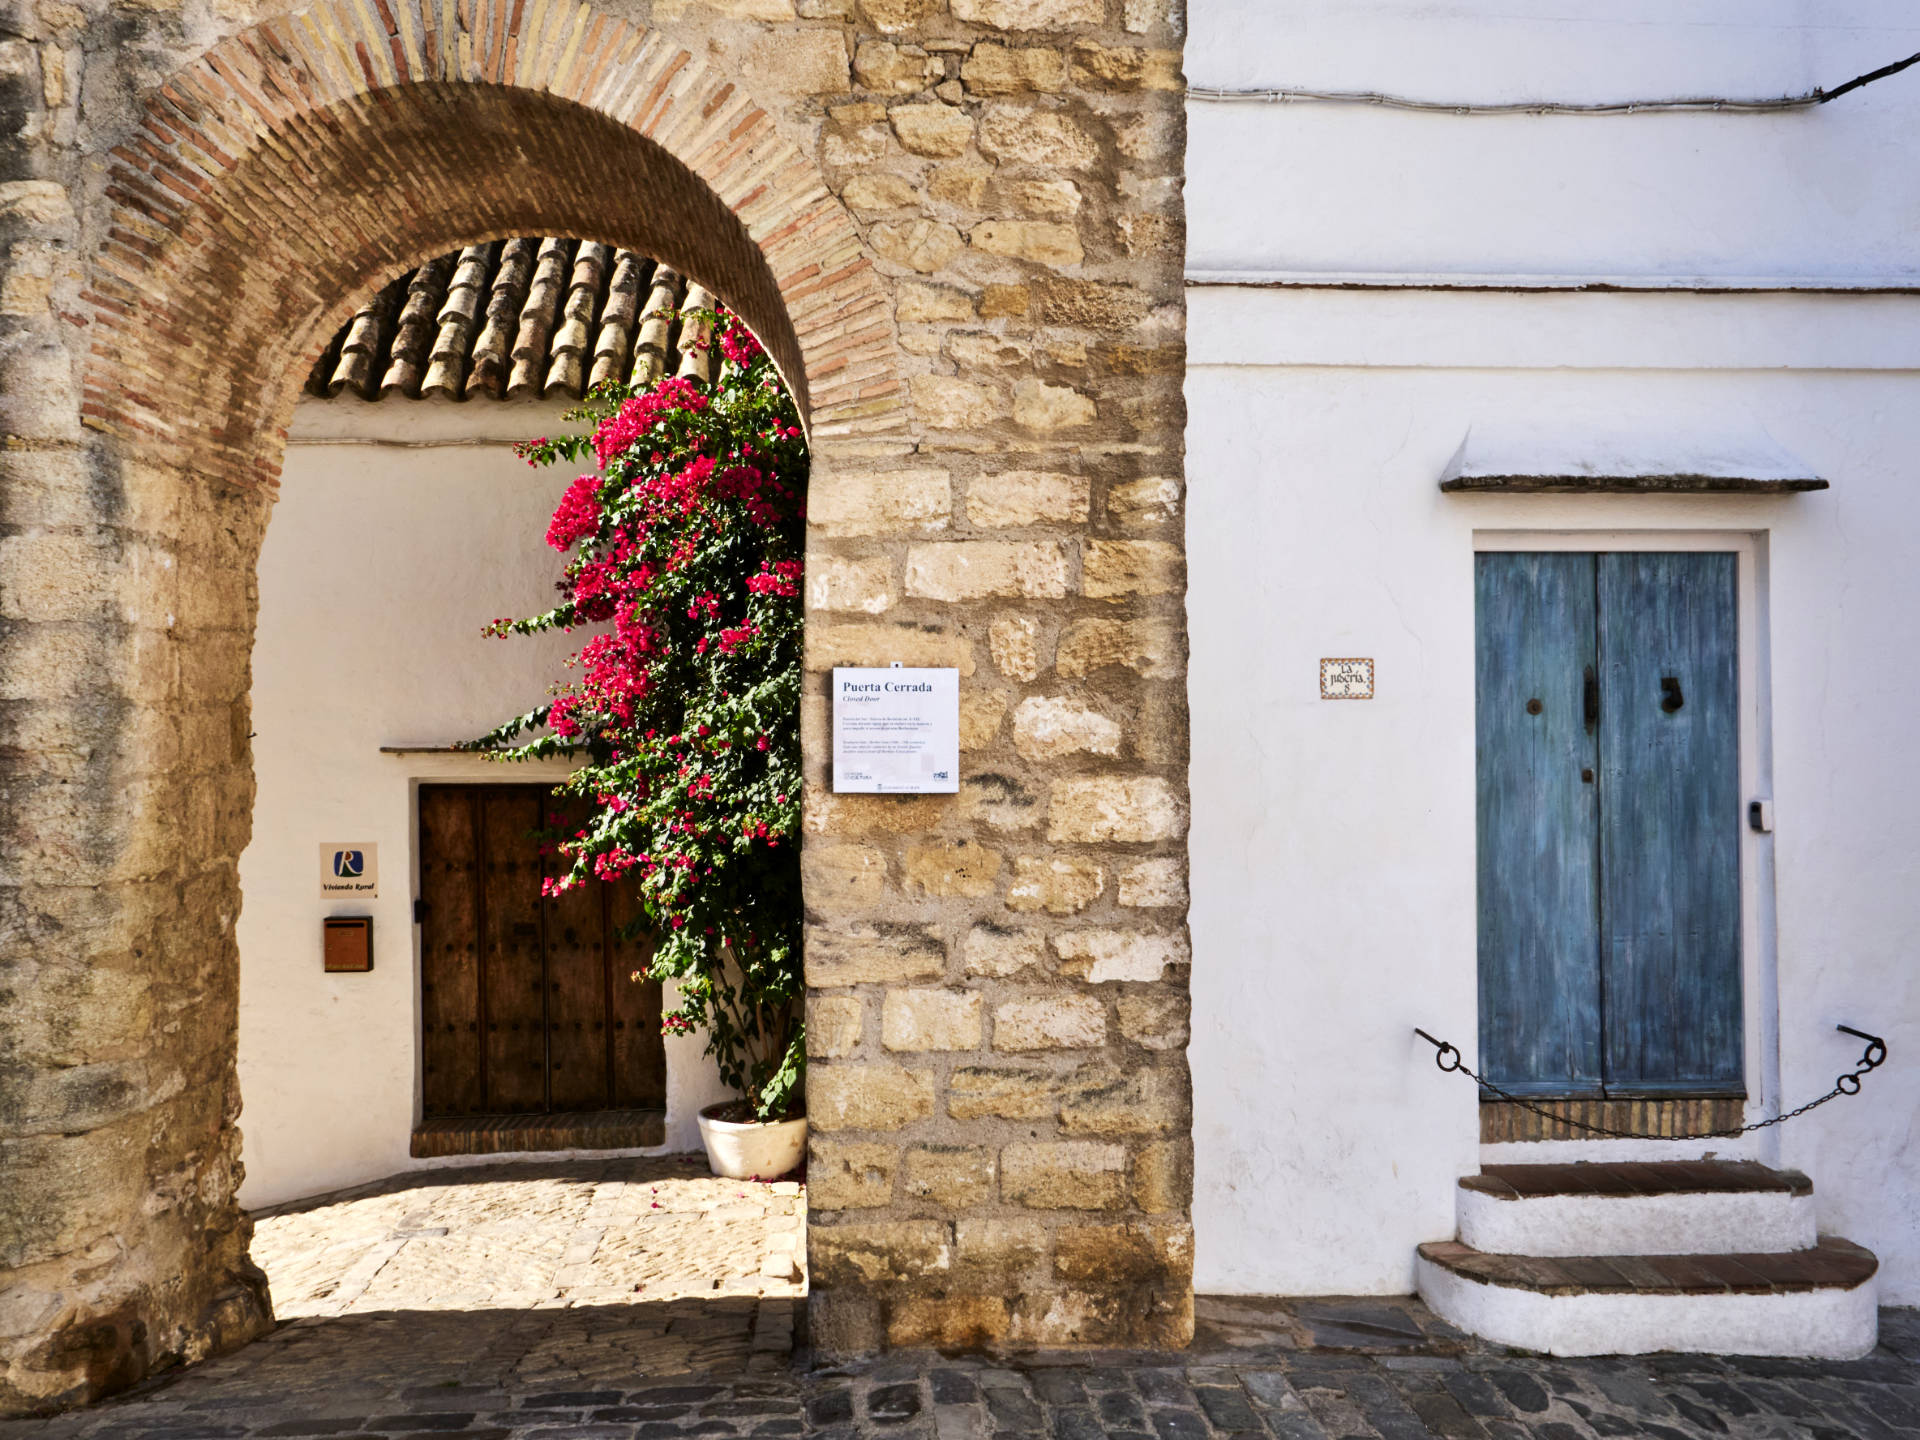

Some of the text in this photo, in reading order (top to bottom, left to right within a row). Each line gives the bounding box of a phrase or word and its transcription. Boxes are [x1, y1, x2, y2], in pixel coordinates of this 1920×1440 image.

[843, 682, 932, 692] Puerta Cerrada
[338, 850, 363, 876] R
[355, 882, 374, 891] Rural
